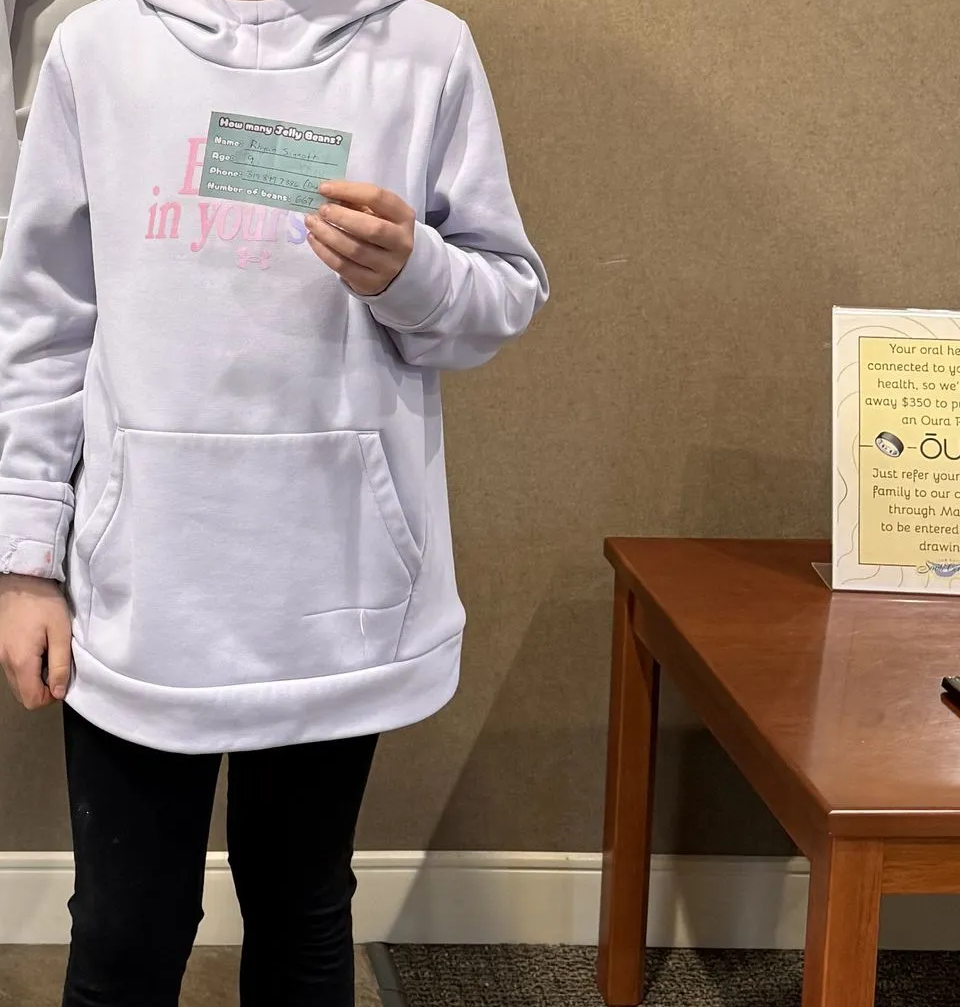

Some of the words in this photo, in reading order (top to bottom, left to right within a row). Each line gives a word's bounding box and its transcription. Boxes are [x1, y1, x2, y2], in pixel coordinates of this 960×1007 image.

[219, 116, 244, 130] How
[245, 123, 273, 135] many
[274, 125, 303, 141] Jelly
[303, 131, 343, 145] Beans?
[214, 136, 242, 147] Name:
[212, 151, 234, 162] Age:
[209, 166, 243, 178] Phone:
[207, 182, 243, 194] Number
[246, 188, 259, 196] of
[261, 191, 292, 202] beans:
[145, 186, 182, 239] in
[191, 201, 308, 252] yours
[889, 343, 916, 354] Your
[920, 345, 943, 355] oral
[947, 345, 960, 356] he
[867, 362, 929, 373] connected
[933, 364, 945, 373] to
[949, 365, 960, 377] yo
[877, 378, 919, 391] health,
[922, 382, 936, 391] so
[939, 381, 959, 391] we'
[865, 397, 897, 410] away
[902, 396, 932, 408] $350
[935, 400, 948, 409] to
[901, 416, 917, 426] an
[920, 415, 952, 426] Oura
[872, 467, 898, 479] Just
[901, 469, 930, 482] refer
[933, 472, 960, 484] your
[872, 485, 911, 500] family
[914, 488, 927, 498] to
[930, 490, 951, 499] our
[888, 504, 936, 519] through
[940, 506, 960, 517] Ma
[881, 522, 894, 532] to
[896, 522, 911, 533] be
[914, 524, 960, 535] entered
[919, 540, 960, 552] drawin
